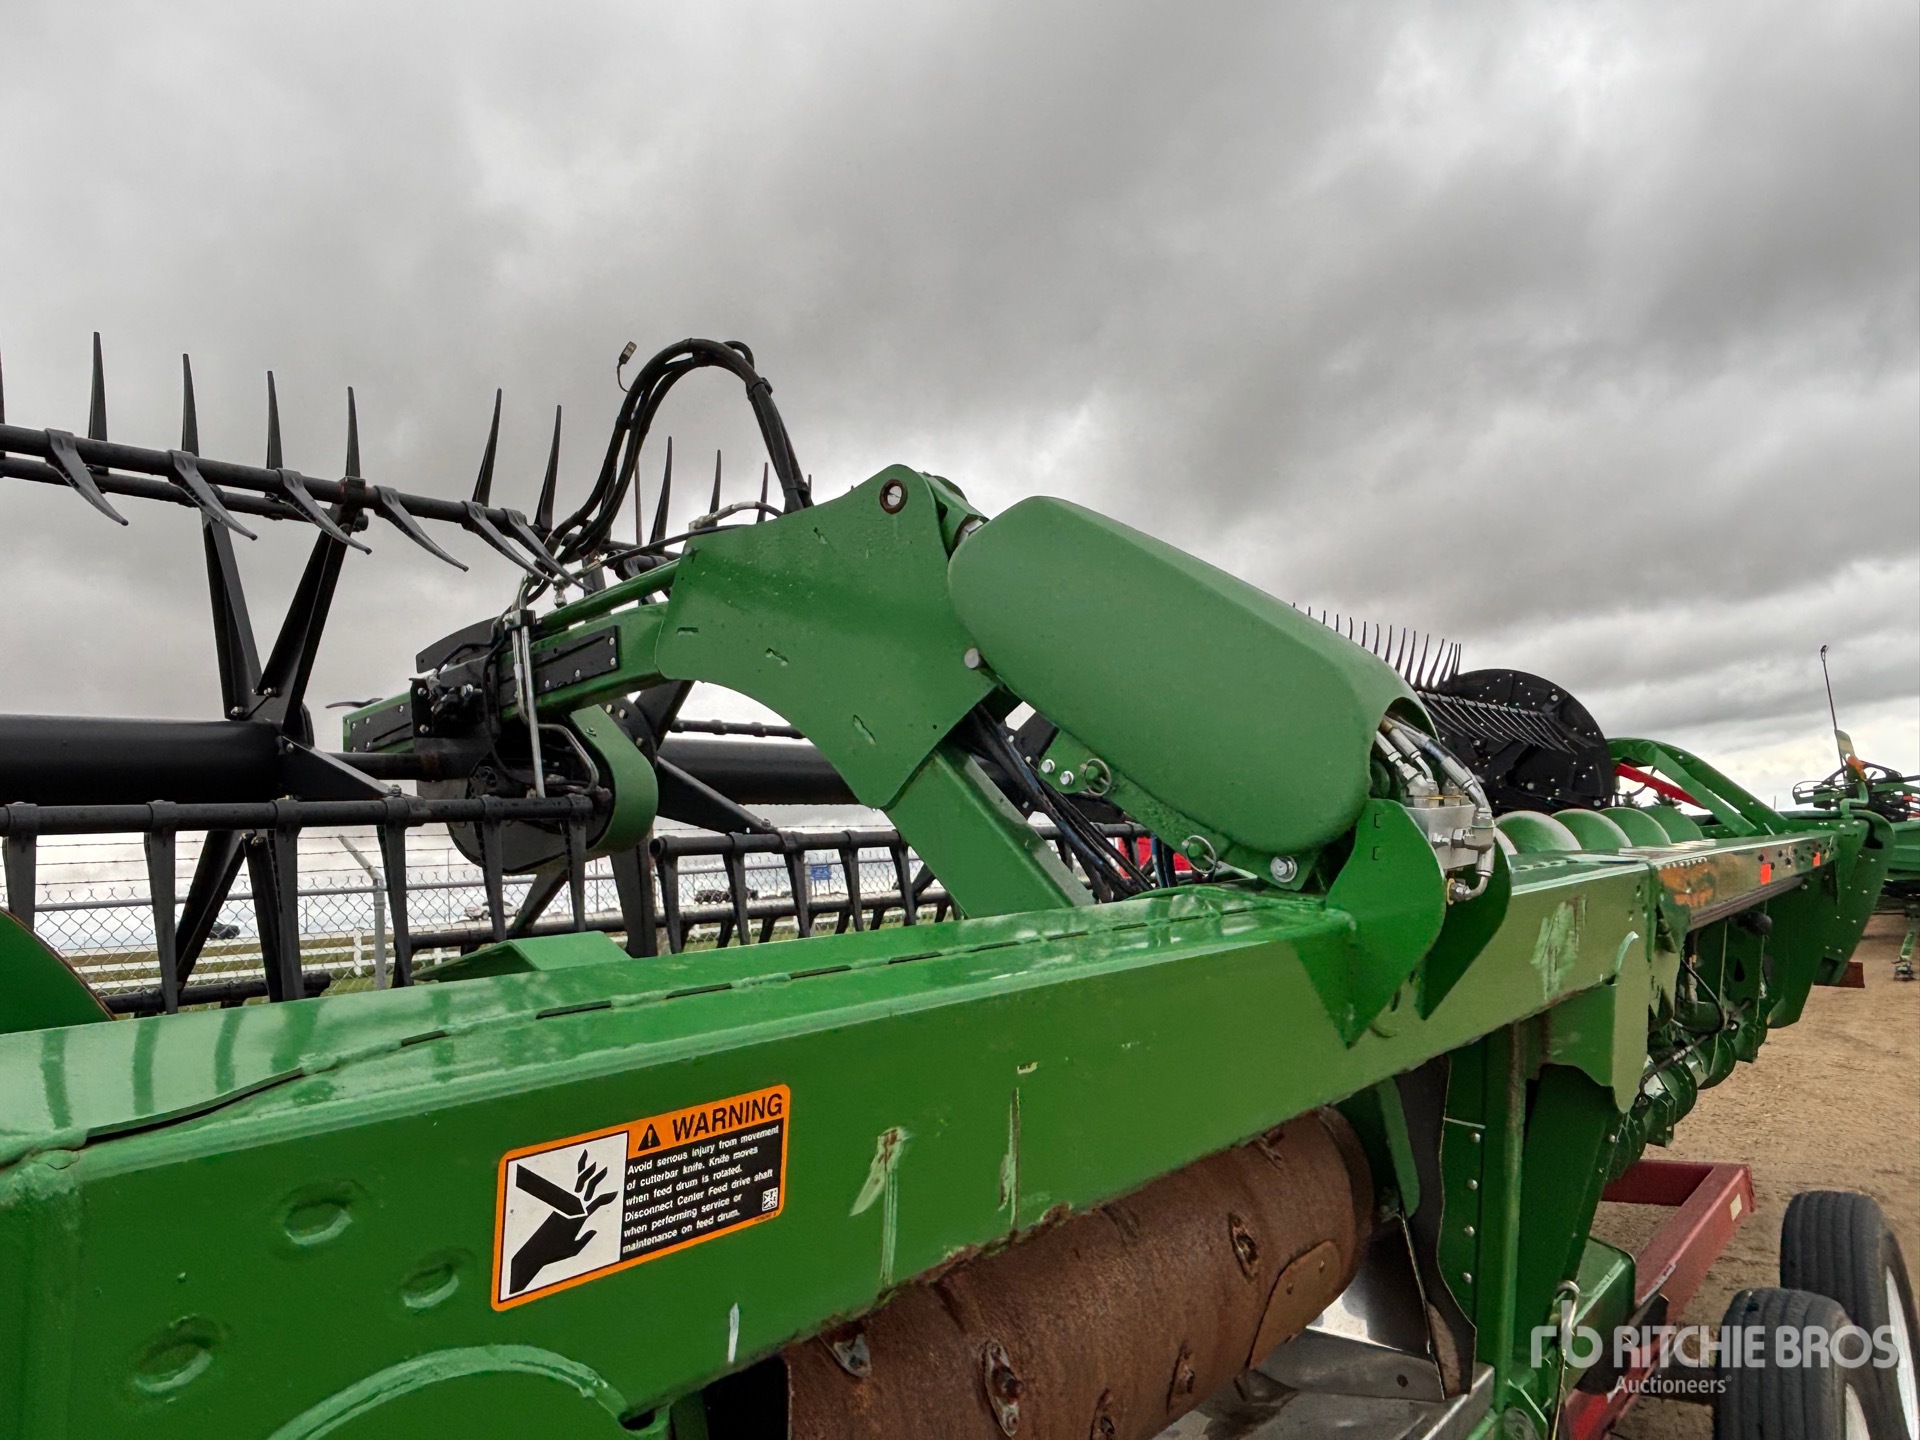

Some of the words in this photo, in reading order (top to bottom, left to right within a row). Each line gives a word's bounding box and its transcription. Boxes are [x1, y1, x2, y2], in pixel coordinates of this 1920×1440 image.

[672, 1093, 783, 1142] WARNING
[626, 1179, 636, 1191] of
[640, 1169, 679, 1187] cutterbar
[682, 1161, 705, 1175] knife.
[708, 1153, 730, 1167] Knife
[732, 1146, 758, 1160] moves
[627, 1159, 653, 1175] Avoid
[656, 1151, 688, 1167] serious
[691, 1144, 715, 1158] injury
[718, 1138, 738, 1150] from
[740, 1125, 779, 1144] movement
[624, 1199, 674, 1223] Disconnect
[677, 1190, 705, 1206] Center
[707, 1182, 728, 1197] Feed
[731, 1177, 751, 1189] drive
[753, 1168, 774, 1182] shaft
[625, 1193, 650, 1207] when
[653, 1184, 673, 1199] feed
[675, 1178, 698, 1191] drum
[701, 1174, 710, 1184] is
[713, 1163, 742, 1180] rotated.
[622, 1229, 678, 1255] maintenance
[681, 1224, 693, 1235] on
[696, 1215, 714, 1229] feed
[717, 1209, 740, 1222] drum.
[623, 1224, 648, 1238] when
[651, 1207, 698, 1231] performing
[701, 1197, 730, 1213] service
[733, 1193, 743, 1203] or
